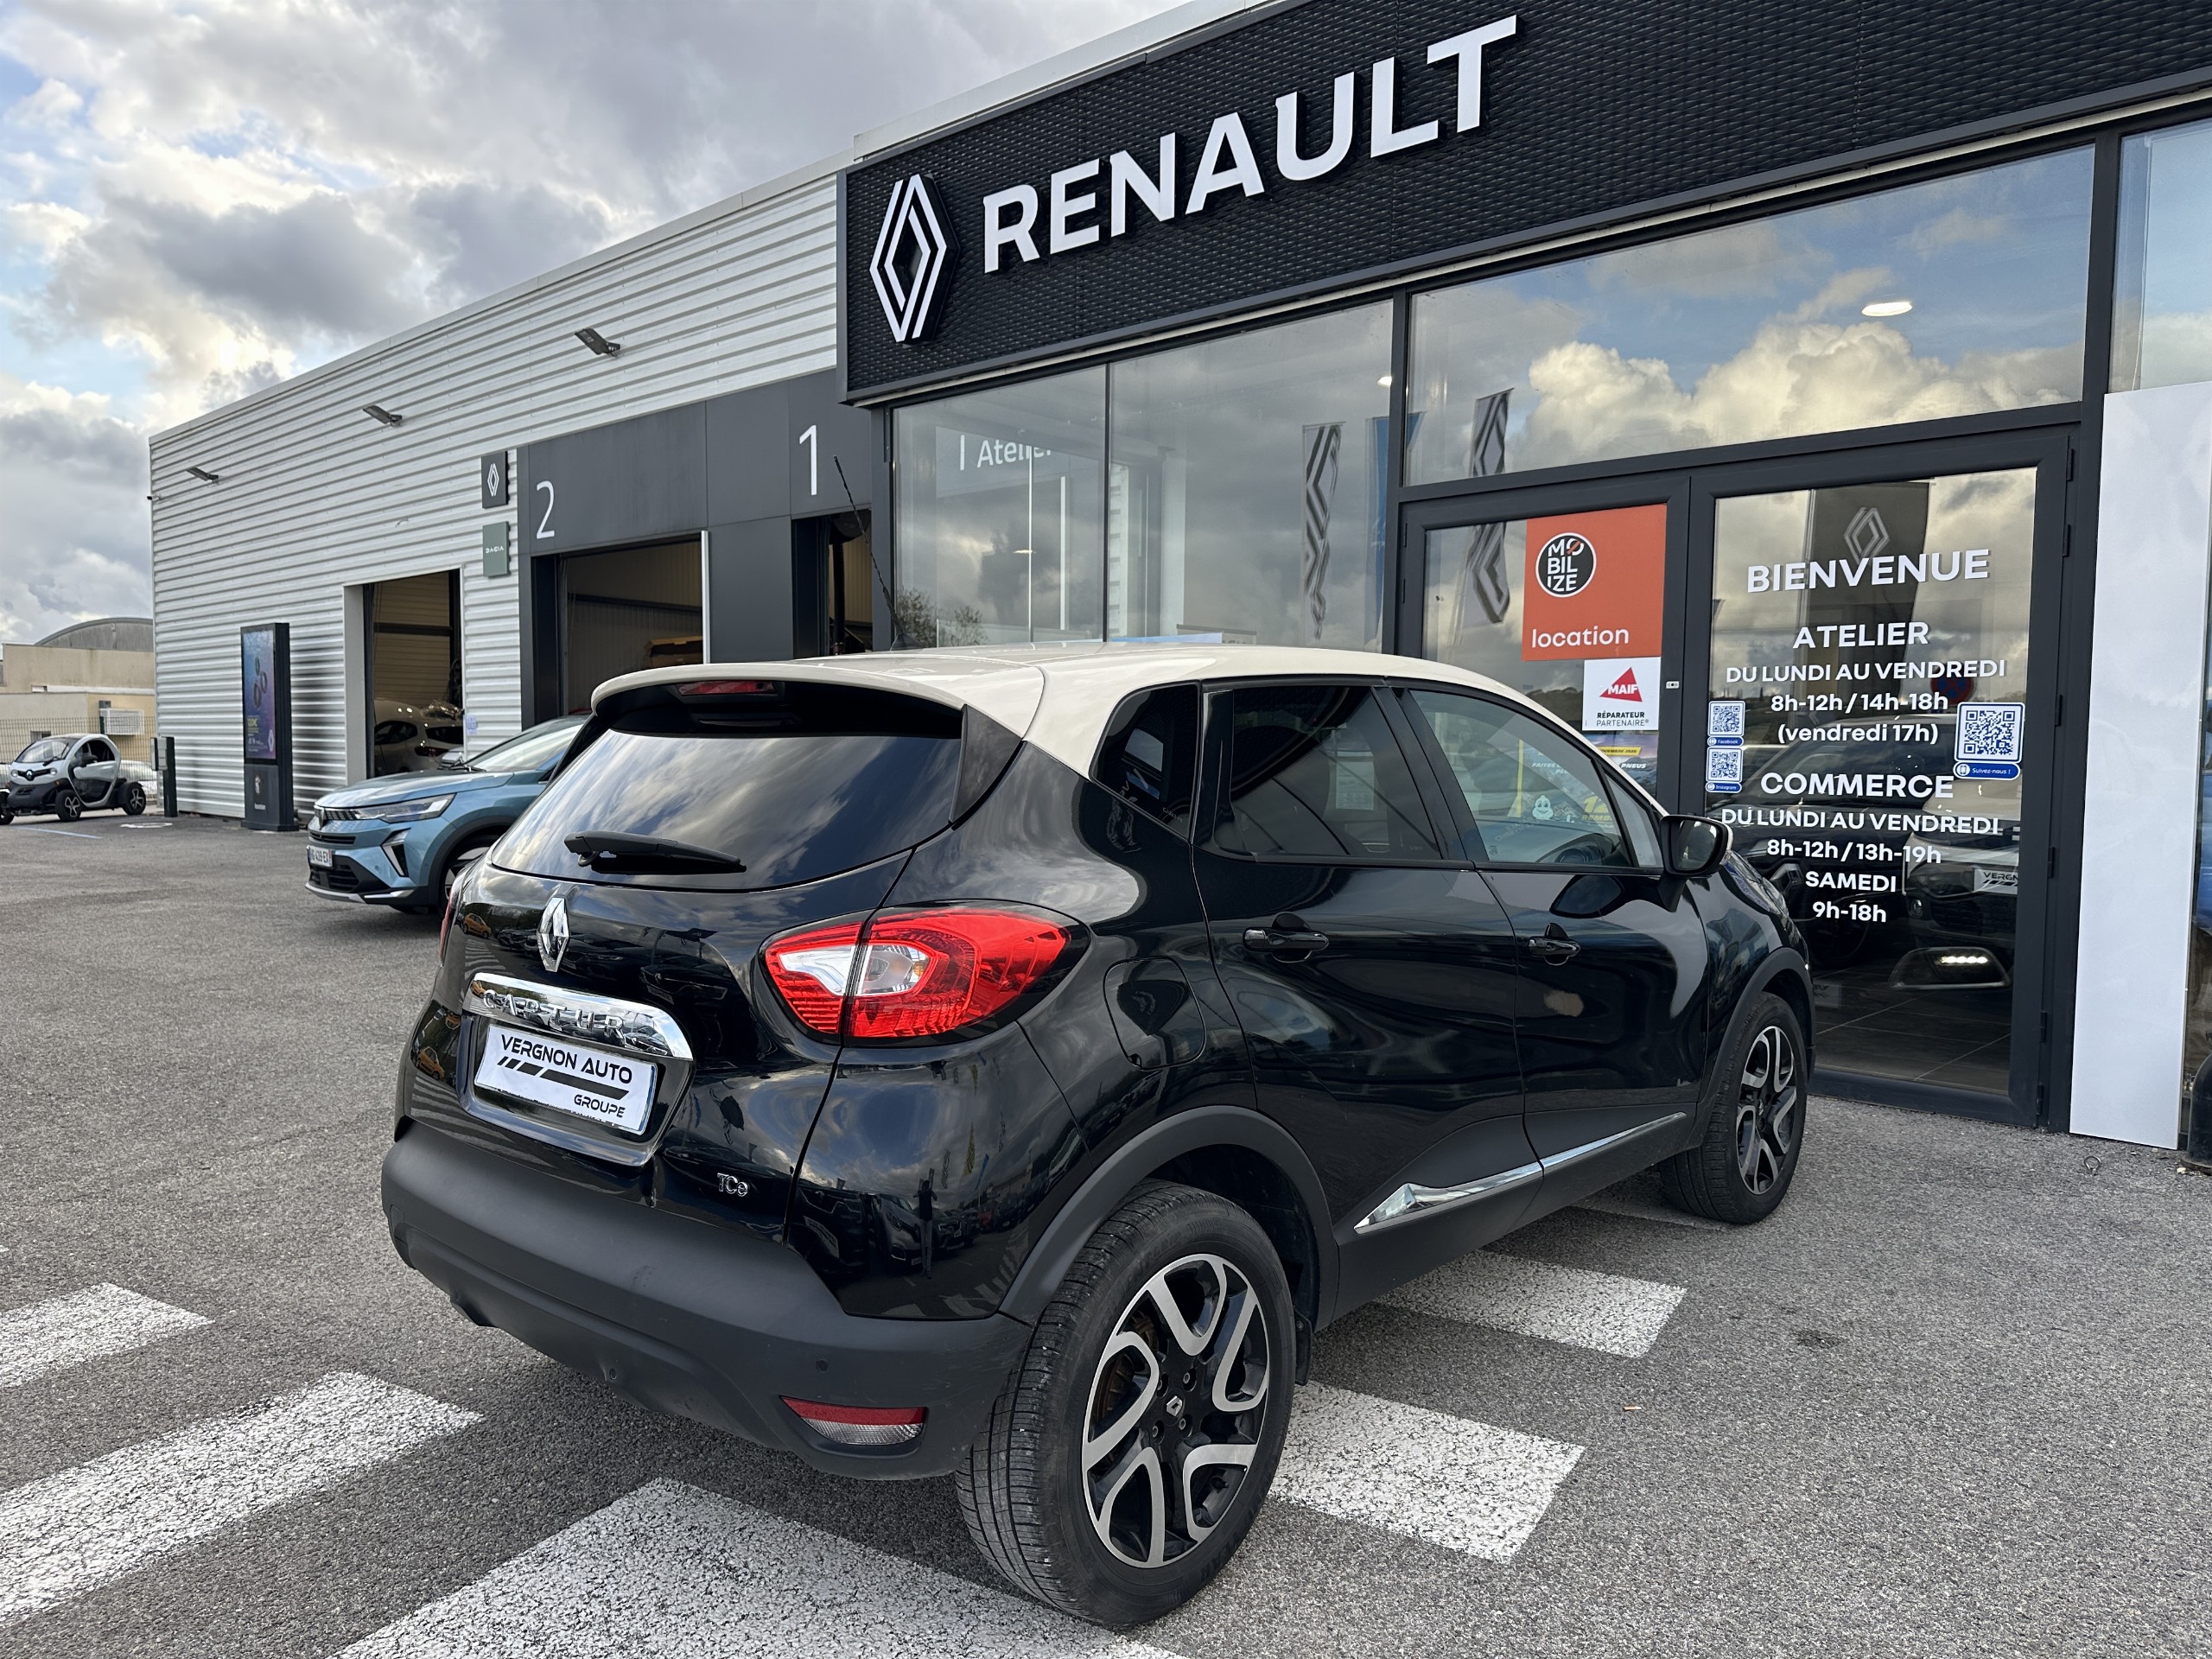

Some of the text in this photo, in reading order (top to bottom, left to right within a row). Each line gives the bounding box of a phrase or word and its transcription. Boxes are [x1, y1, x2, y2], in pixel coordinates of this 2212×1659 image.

[982, 14, 1517, 274] RENAULT
[798, 424, 817, 496] 1
[536, 480, 556, 540] 2
[485, 545, 505, 554] DACIA
[1747, 549, 1989, 593] BIENVENUE
[1531, 625, 1630, 648] location
[1792, 621, 1930, 649] ATELIER
[1726, 659, 2005, 683] DU LUNDI AU VENDREDI
[1607, 683, 1639, 695] MAIF
[1770, 694, 1843, 712] 8h-12h
[1861, 692, 1948, 711] 14h-18h
[1597, 710, 1645, 719] RÉPARATEUR
[1777, 723, 1939, 744] (vendredi 17h)
[1760, 772, 1955, 798] COMMERCE
[1721, 809, 1999, 835] DU LUNDI AU VENDREDI
[1767, 840, 1839, 859] 8h-12h
[1856, 842, 1942, 864] 13h-19h
[1805, 871, 1897, 893] SAMEDI
[1812, 901, 1886, 923] 9h-18h
[482, 988, 626, 1048] CAPTUR
[500, 1033, 632, 1084] VERGNON AUTO
[573, 1094, 626, 1118] GROUPE
[716, 1172, 748, 1197] TCe
